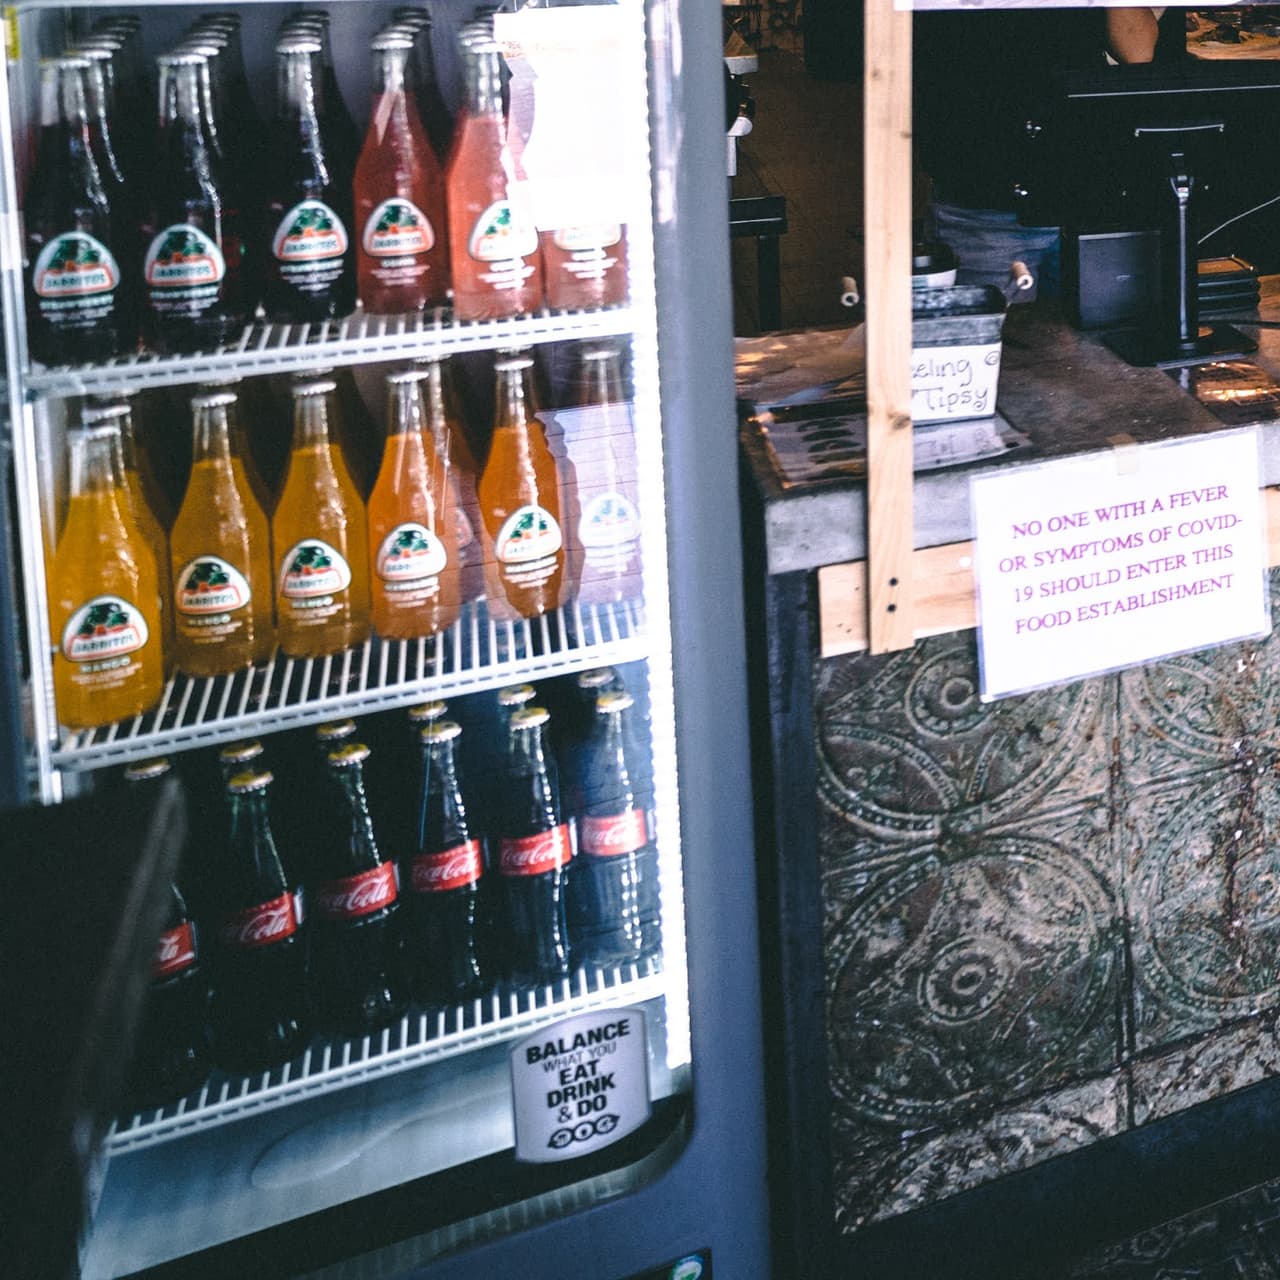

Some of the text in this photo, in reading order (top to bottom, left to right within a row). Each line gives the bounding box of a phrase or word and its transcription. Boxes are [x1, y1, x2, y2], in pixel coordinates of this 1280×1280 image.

[912, 357, 973, 388] eling
[911, 386, 989, 413] Tipsy
[1012, 485, 1229, 539] NO ONE WITH A FEVER
[999, 513, 1243, 573] OR SYMPTOMS OF COVID-
[1015, 544, 1234, 603] 19 SHOULD ENTER THIS
[1015, 573, 1234, 634] FOOD ESTABLISHMENT
[525, 1018, 631, 1066] BALANCE
[588, 1041, 617, 1059] YOU
[546, 1071, 617, 1109] DRINK
[559, 1059, 600, 1086] EAT
[557, 1093, 607, 1124] & DO
